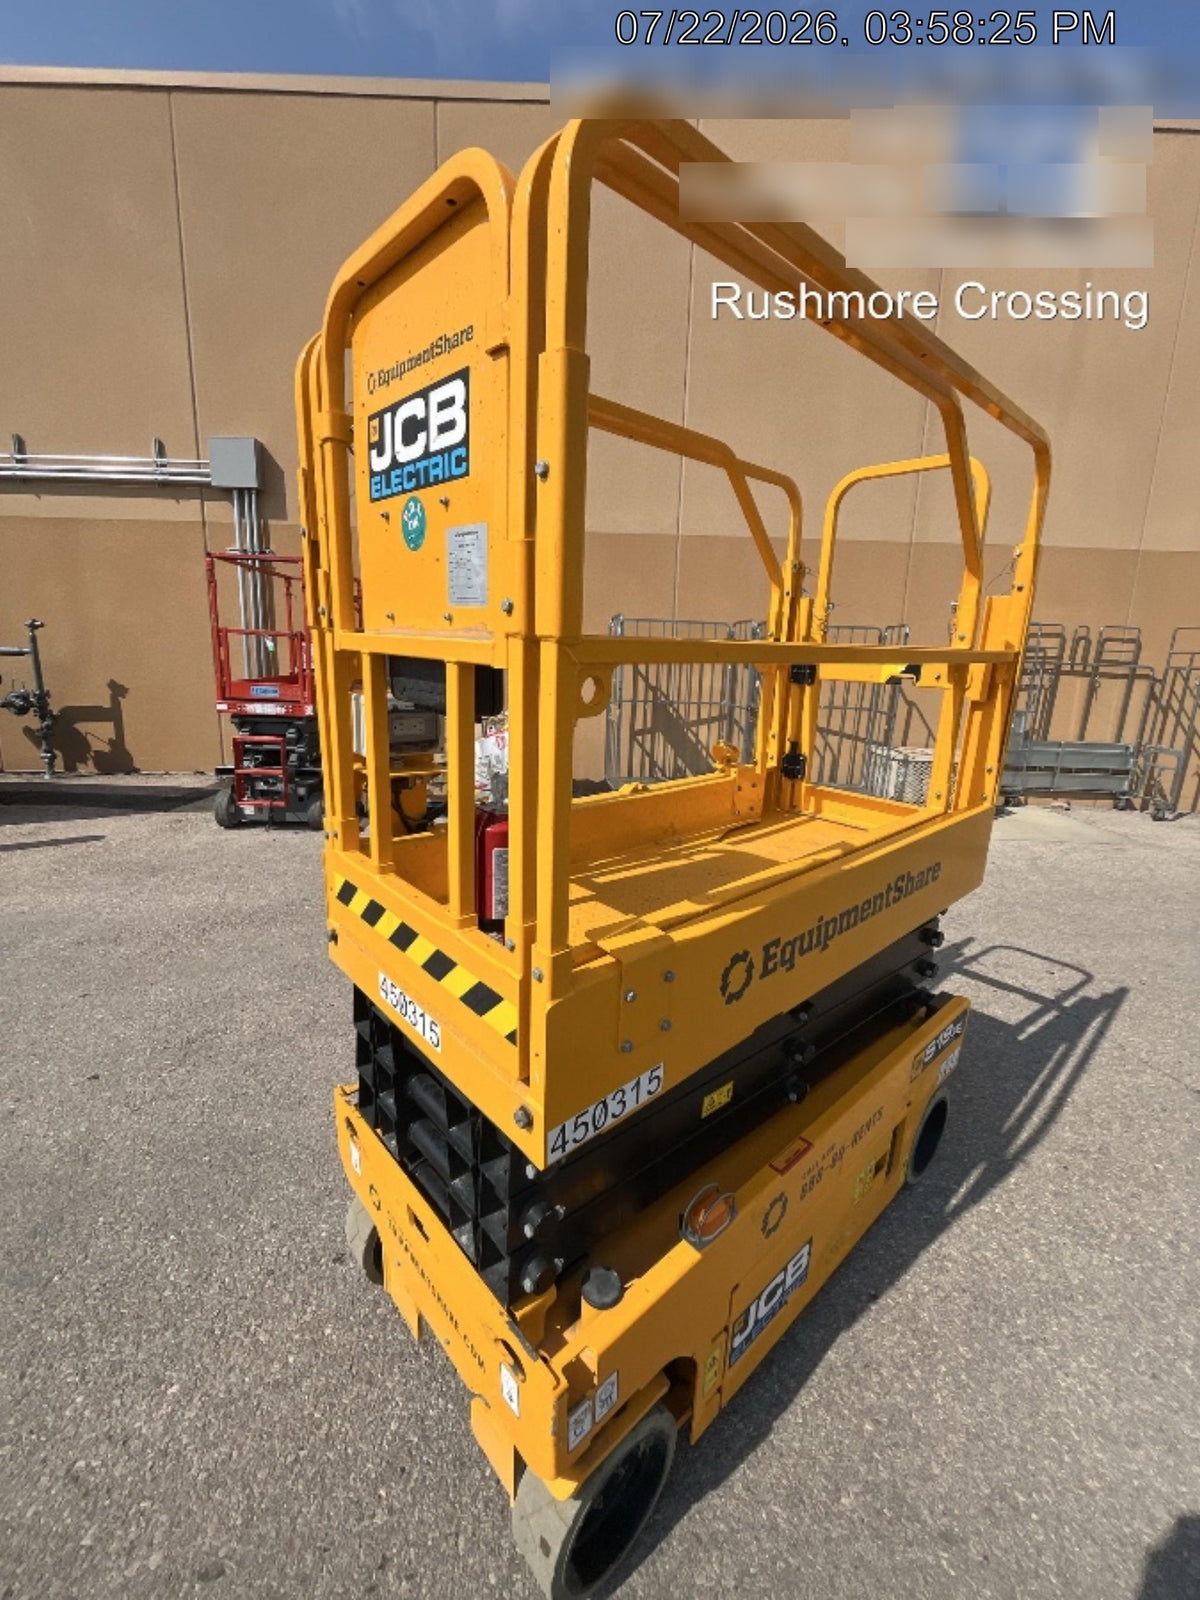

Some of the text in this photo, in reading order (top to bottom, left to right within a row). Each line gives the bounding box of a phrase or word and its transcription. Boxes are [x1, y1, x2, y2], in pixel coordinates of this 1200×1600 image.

[378, 325, 474, 387] EquipmentShare
[370, 378, 466, 472] JCB
[371, 447, 467, 499] ELECTRIC
[759, 862, 942, 980] EquipmentShare
[380, 975, 440, 1048] 450315
[550, 1067, 662, 1154] 450315
[732, 1244, 810, 1348] JCB
